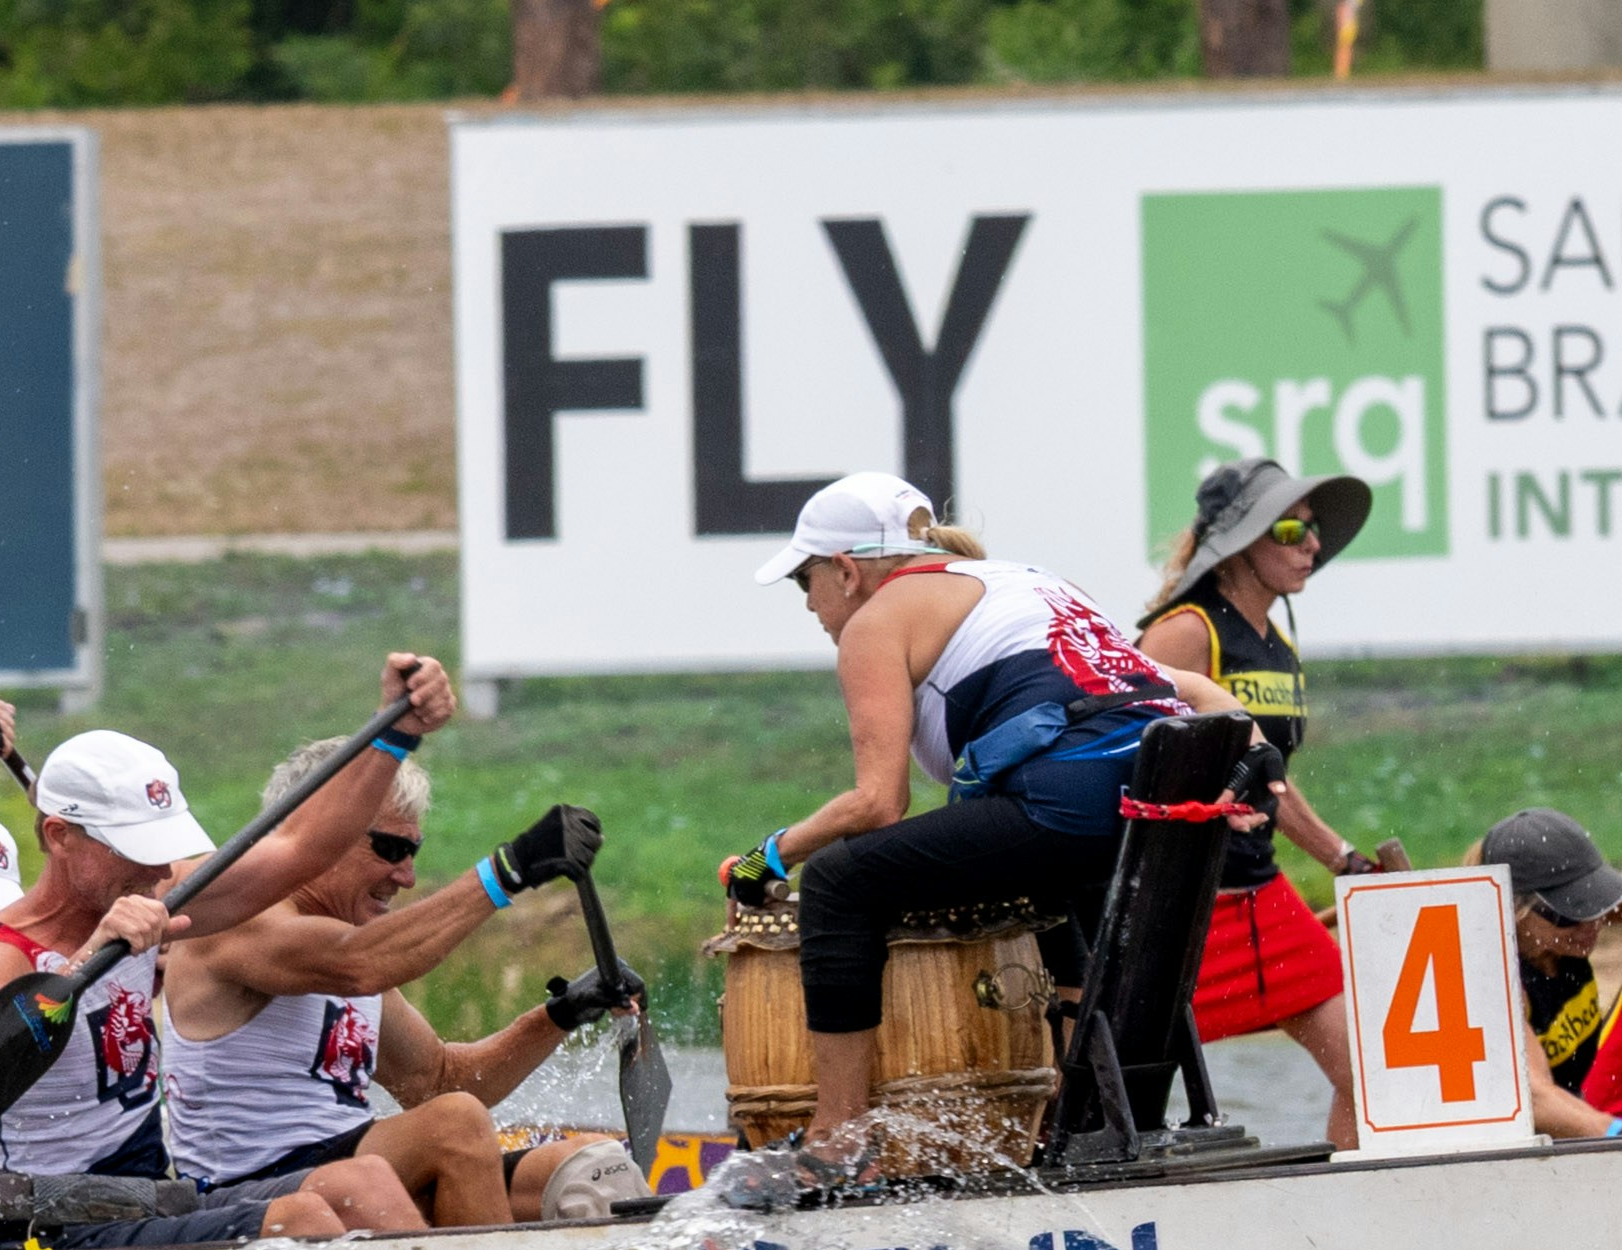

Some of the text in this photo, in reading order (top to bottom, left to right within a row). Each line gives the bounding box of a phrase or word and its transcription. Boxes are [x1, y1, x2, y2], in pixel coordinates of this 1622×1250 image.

[498, 211, 1036, 541] FLY
[1196, 375, 1430, 531] srq
[1483, 324, 1622, 422] BR
[1381, 904, 1487, 1104] 4
